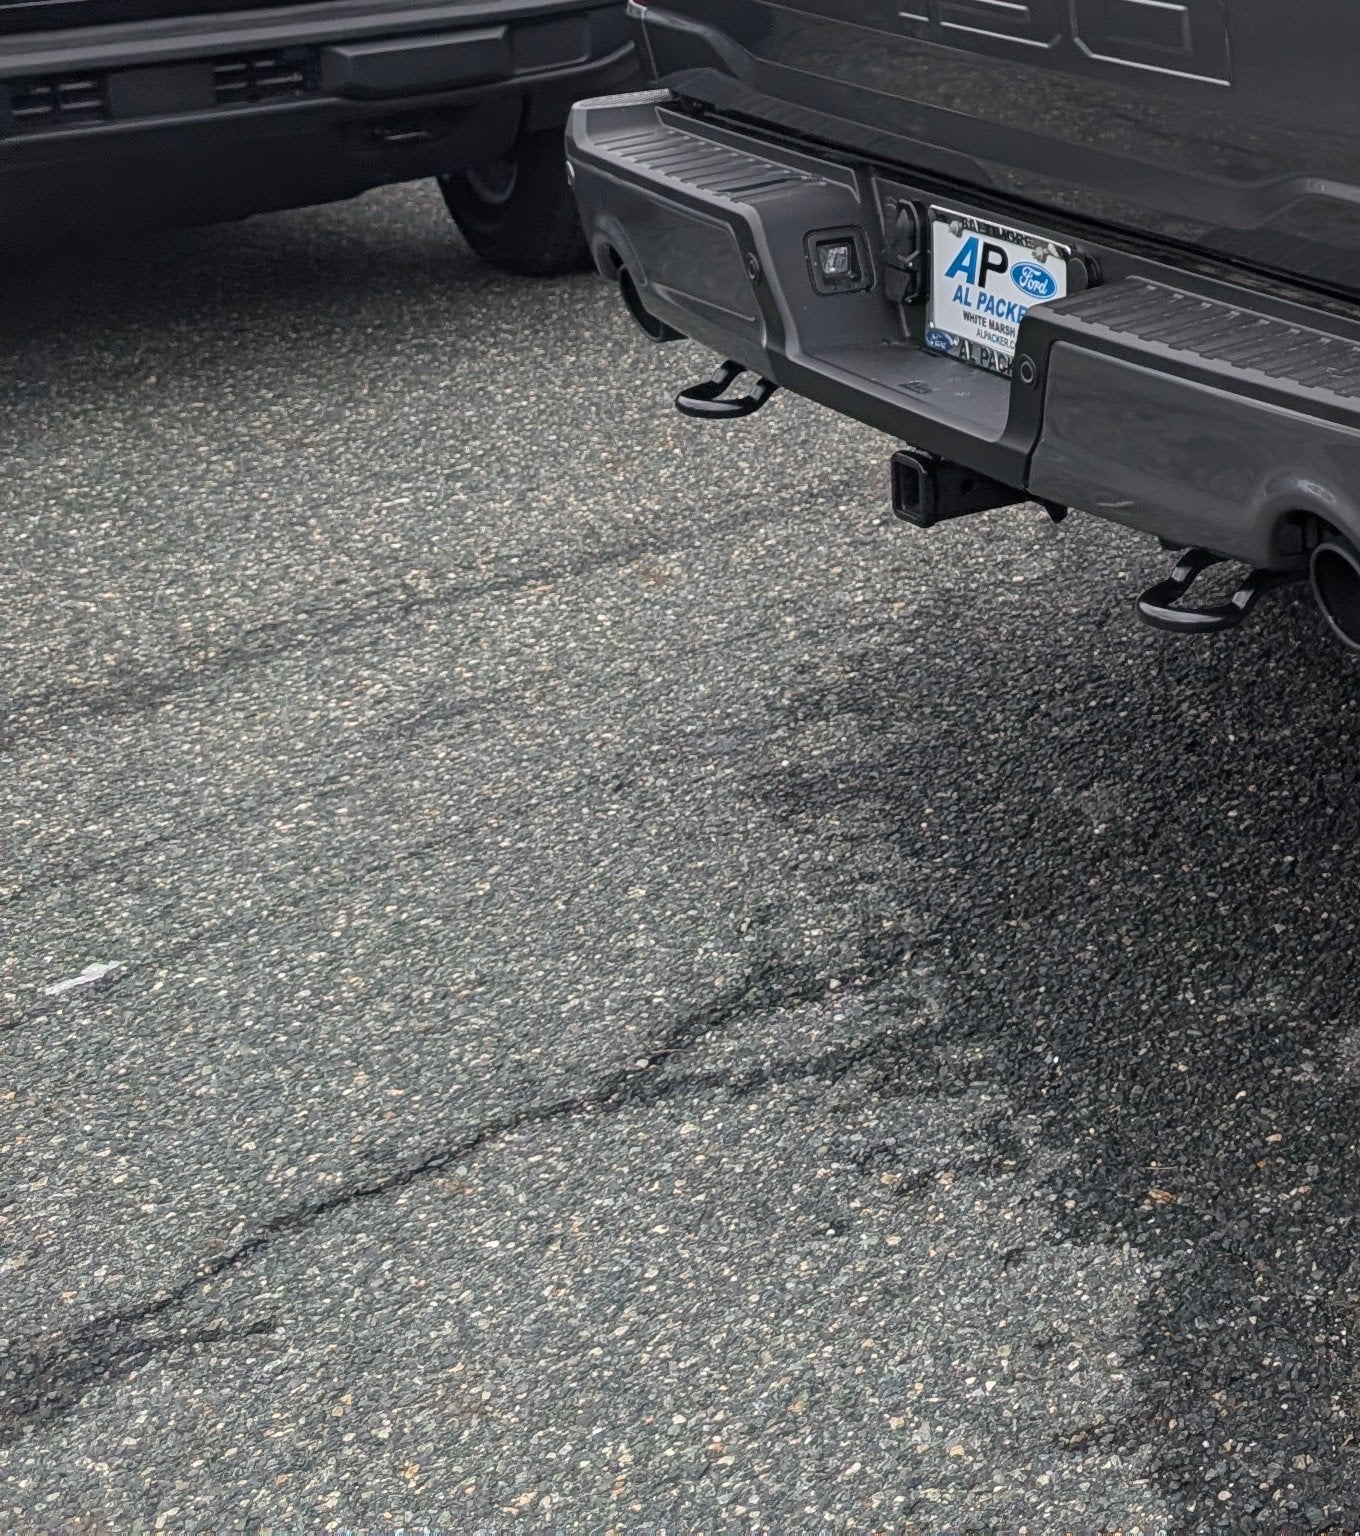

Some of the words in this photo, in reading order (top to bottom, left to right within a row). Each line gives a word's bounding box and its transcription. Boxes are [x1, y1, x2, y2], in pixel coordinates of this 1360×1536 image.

[944, 236, 1009, 289] AP
[1020, 266, 1049, 295] Ford
[953, 285, 972, 307] AL
[963, 310, 987, 328] WHITE
[989, 319, 1016, 337] MARSH
